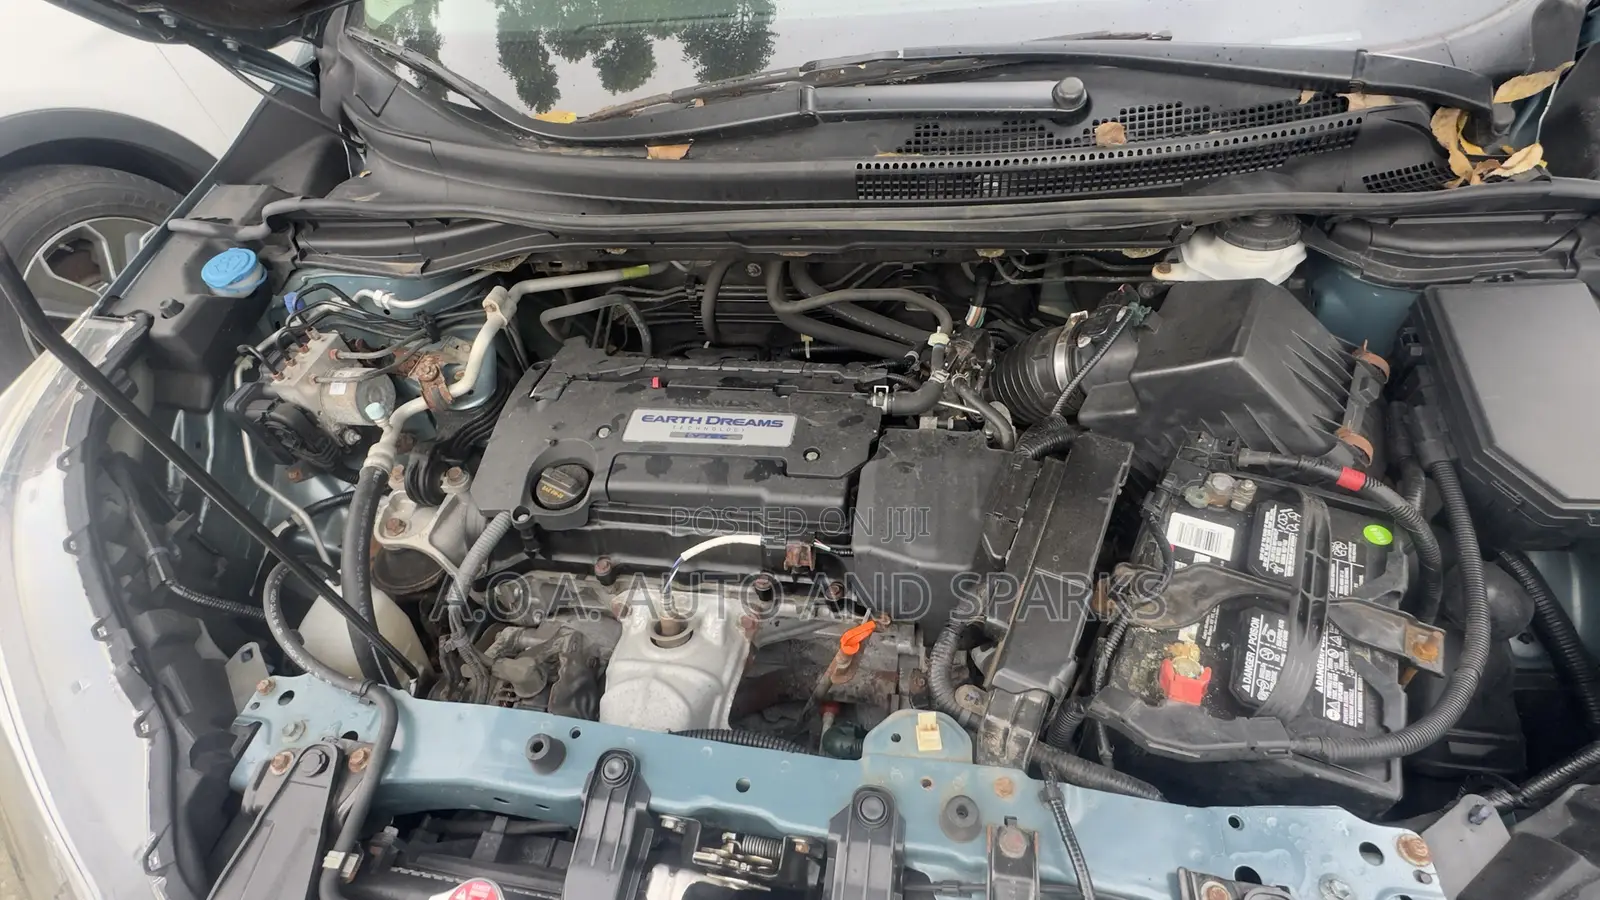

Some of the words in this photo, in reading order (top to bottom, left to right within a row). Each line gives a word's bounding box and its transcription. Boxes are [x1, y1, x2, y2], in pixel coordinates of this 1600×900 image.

[641, 414, 701, 425] EARTH
[705, 415, 784, 428] DREAMS
[672, 425, 745, 433] TECHNOLOGY
[1248, 617, 1260, 646] POISON
[1242, 651, 1256, 683] DANGER
